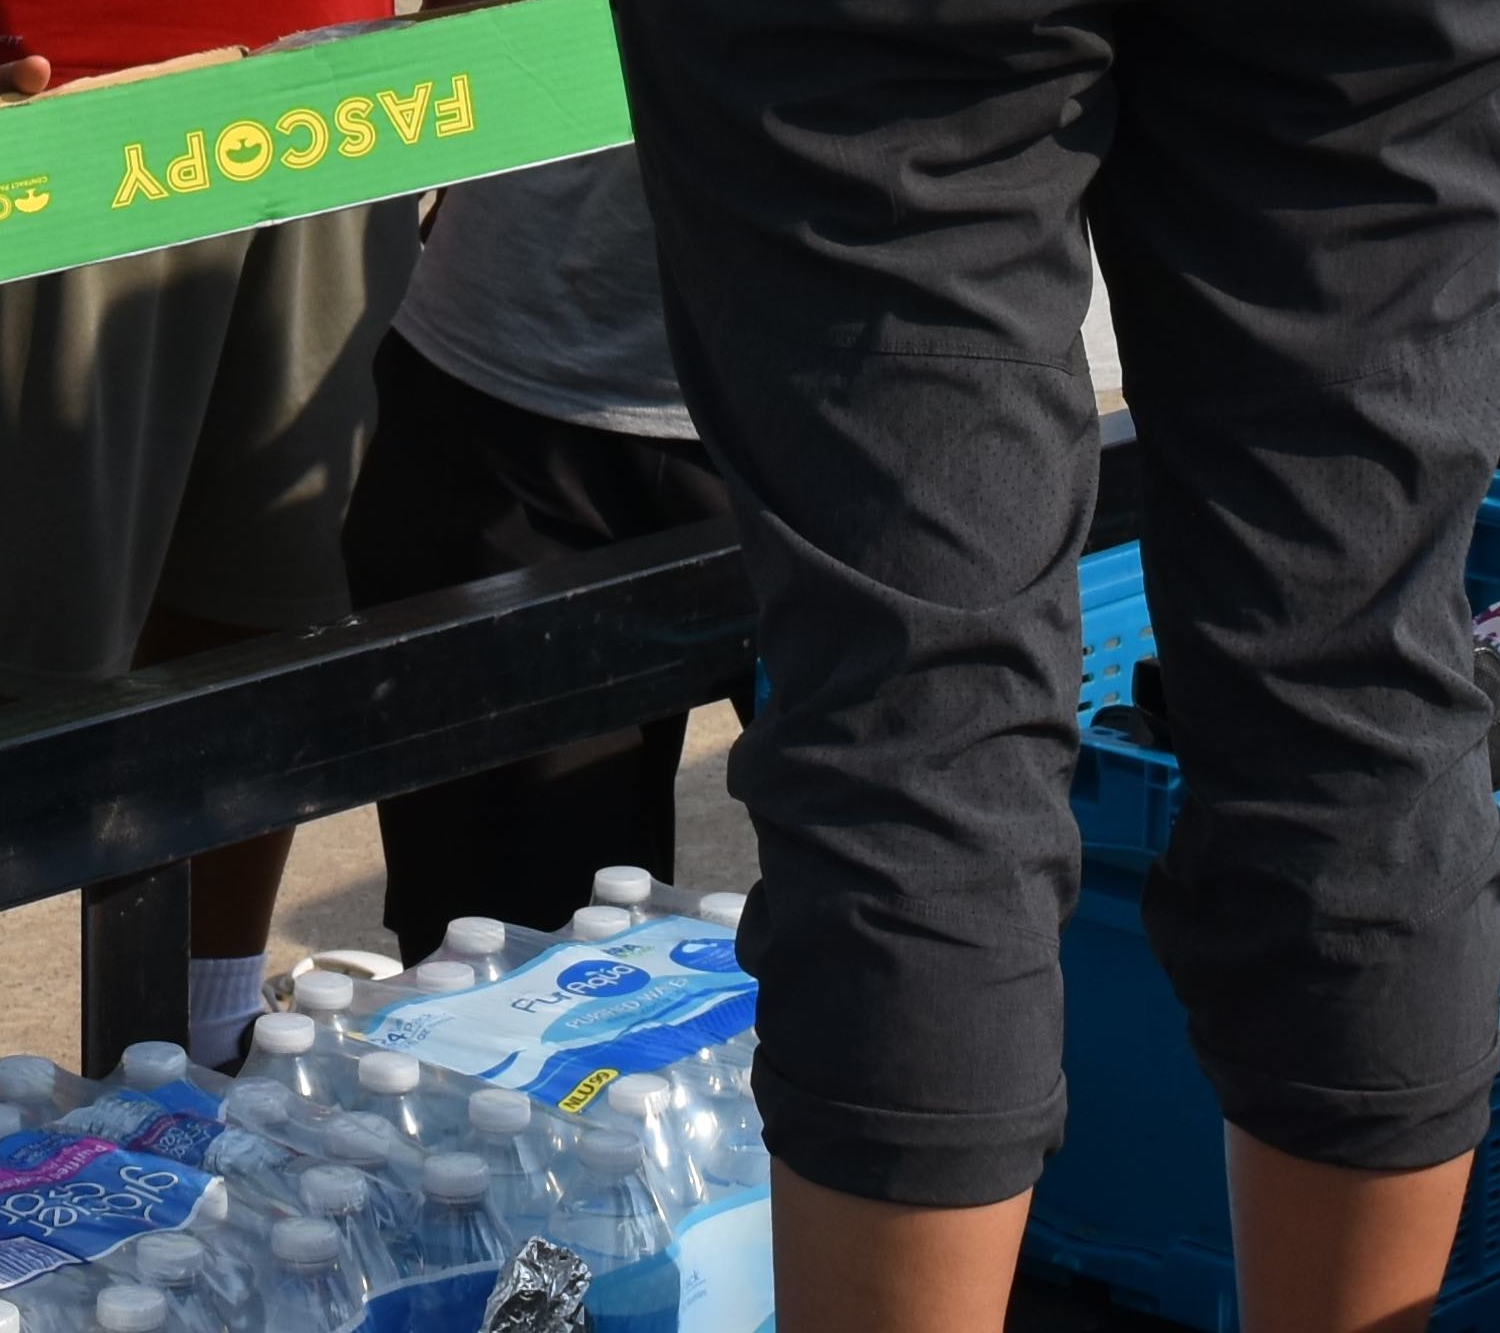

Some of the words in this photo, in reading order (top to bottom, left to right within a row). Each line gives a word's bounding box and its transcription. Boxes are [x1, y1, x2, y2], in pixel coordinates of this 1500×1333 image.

[111, 73, 475, 209] FASCOPY
[562, 1082, 595, 1110] NLU
[589, 1071, 611, 1084] 99
